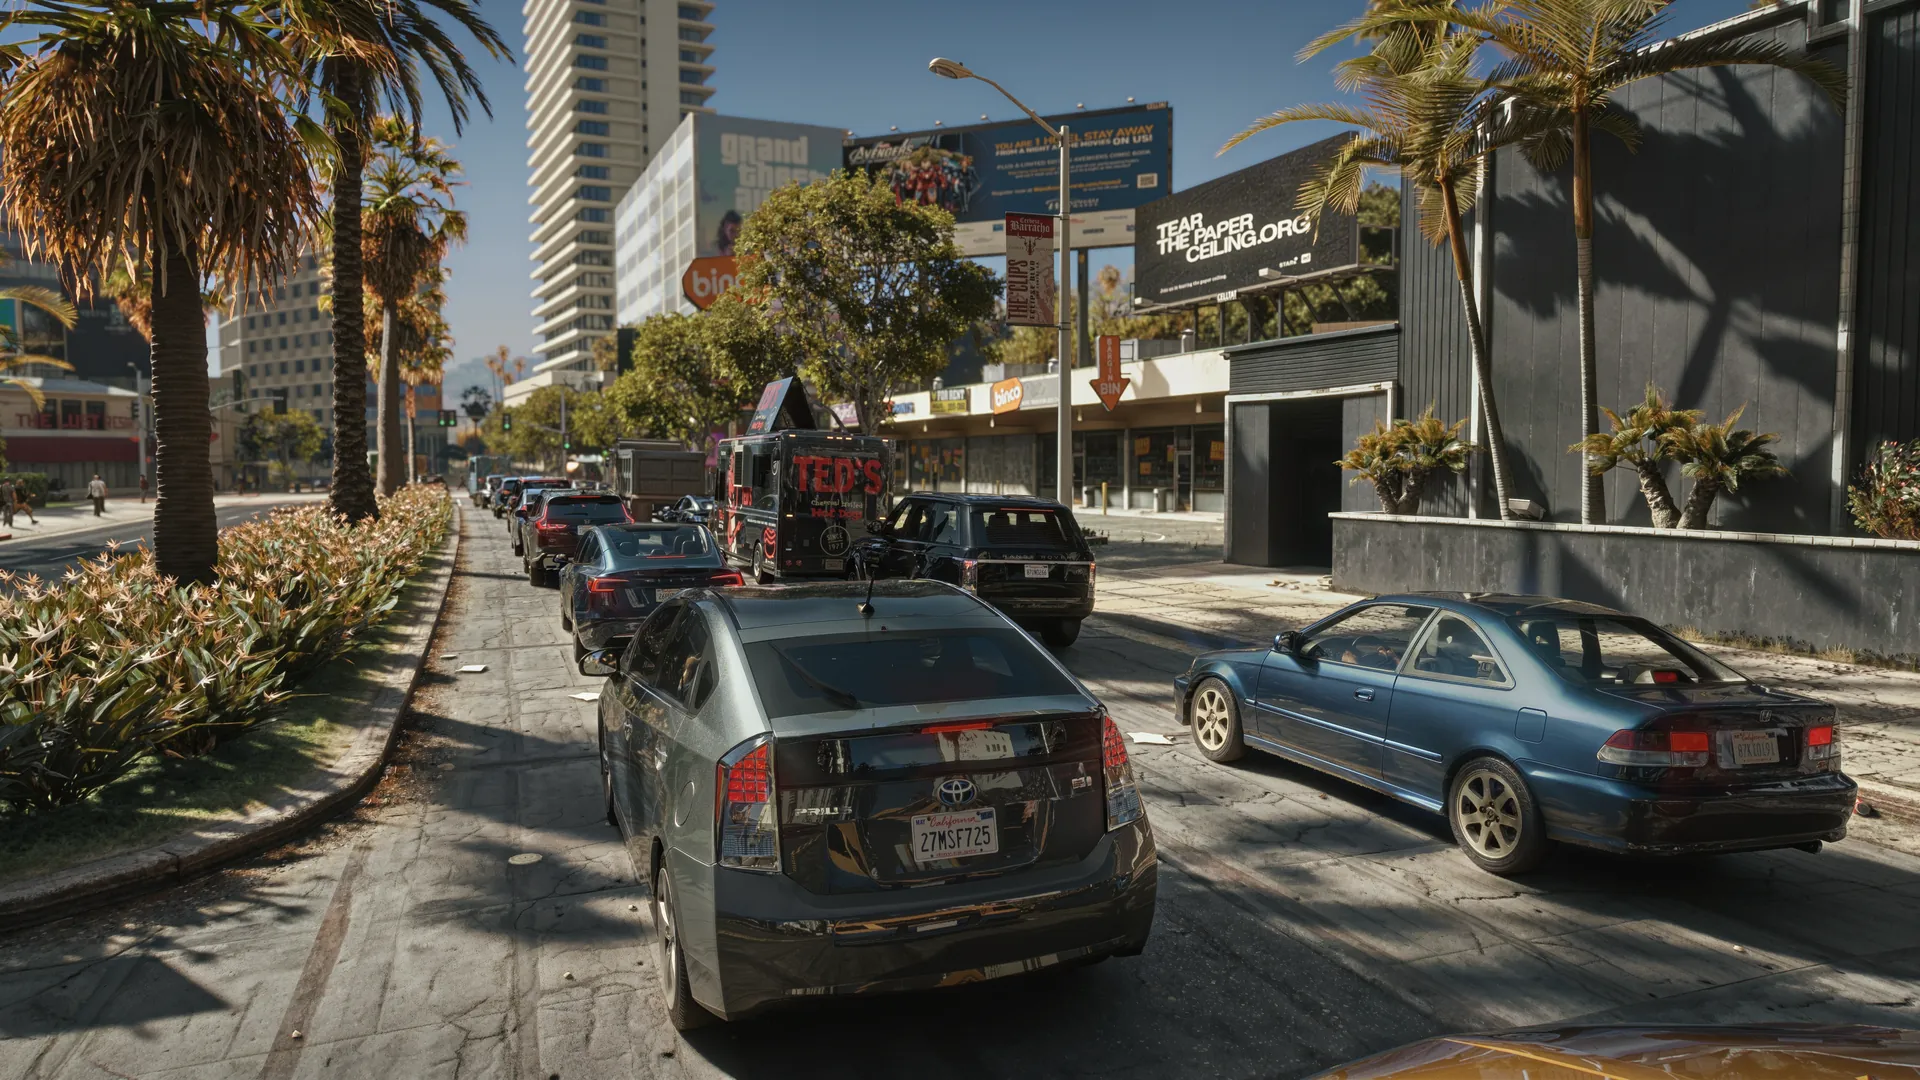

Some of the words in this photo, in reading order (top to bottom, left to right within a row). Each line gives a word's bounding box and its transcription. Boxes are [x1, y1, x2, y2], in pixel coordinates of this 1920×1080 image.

[1084, 129, 1115, 141] STAY
[1116, 124, 1154, 138] AWAY
[996, 149, 1018, 157] FROM
[1080, 139, 1112, 148] MOVIES
[1113, 137, 1130, 147] ON
[1133, 133, 1153, 145] US!
[1010, 220, 1050, 233] Barracho
[1156, 212, 1204, 240] TEAR
[1156, 231, 1191, 256] THE
[1193, 212, 1254, 245] PAPER
[1185, 215, 1312, 263] CEILING.ORG
[692, 267, 747, 298] binc
[993, 385, 1021, 407] binco
[1100, 381, 1121, 396] BIN
[792, 456, 883, 494] TED'S
[826, 532, 844, 541] SINCE
[794, 805, 853, 817] PRIUS
[915, 818, 926, 826] MAY
[929, 814, 981, 829] California
[920, 825, 991, 853] 27MSF725
